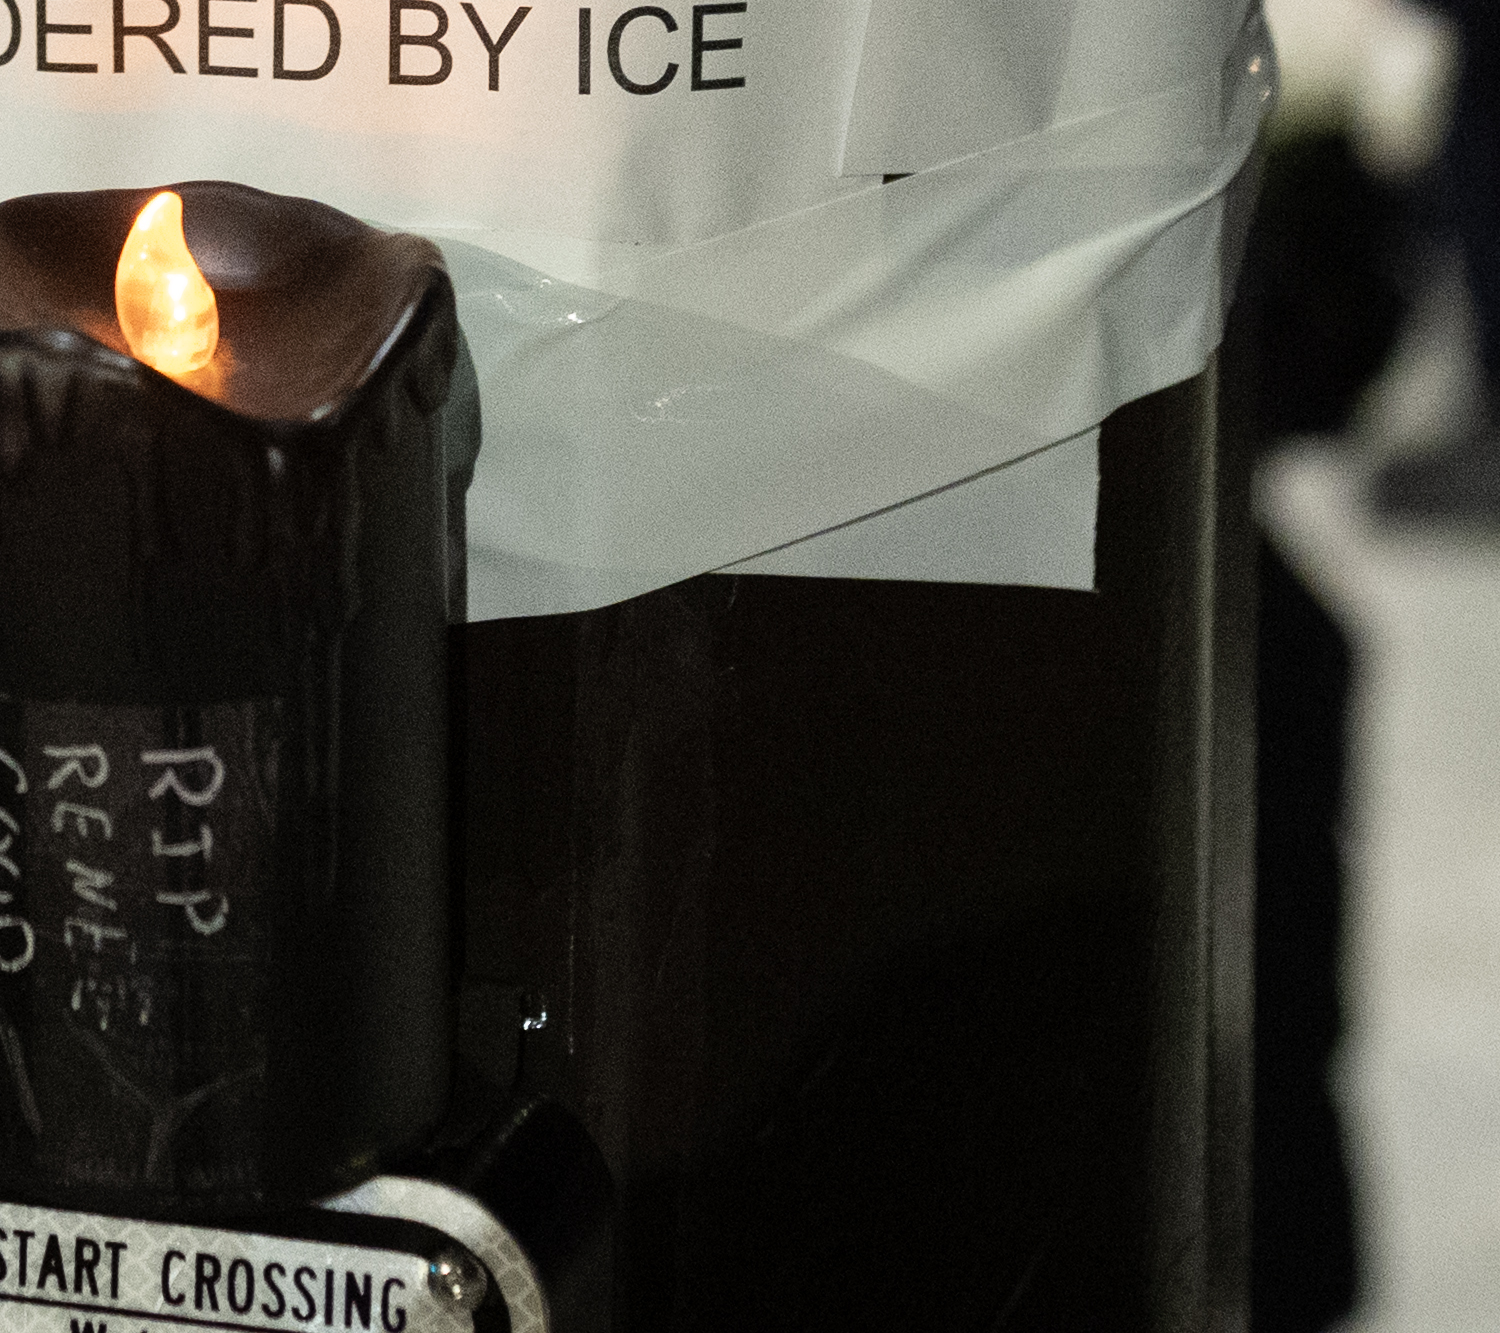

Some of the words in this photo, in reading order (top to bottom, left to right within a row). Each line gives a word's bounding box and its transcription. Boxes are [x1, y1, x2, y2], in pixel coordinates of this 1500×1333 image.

[576, 1, 750, 96] ICE
[140, 745, 230, 936] RIP
[161, 1249, 408, 1333] CROSSING
